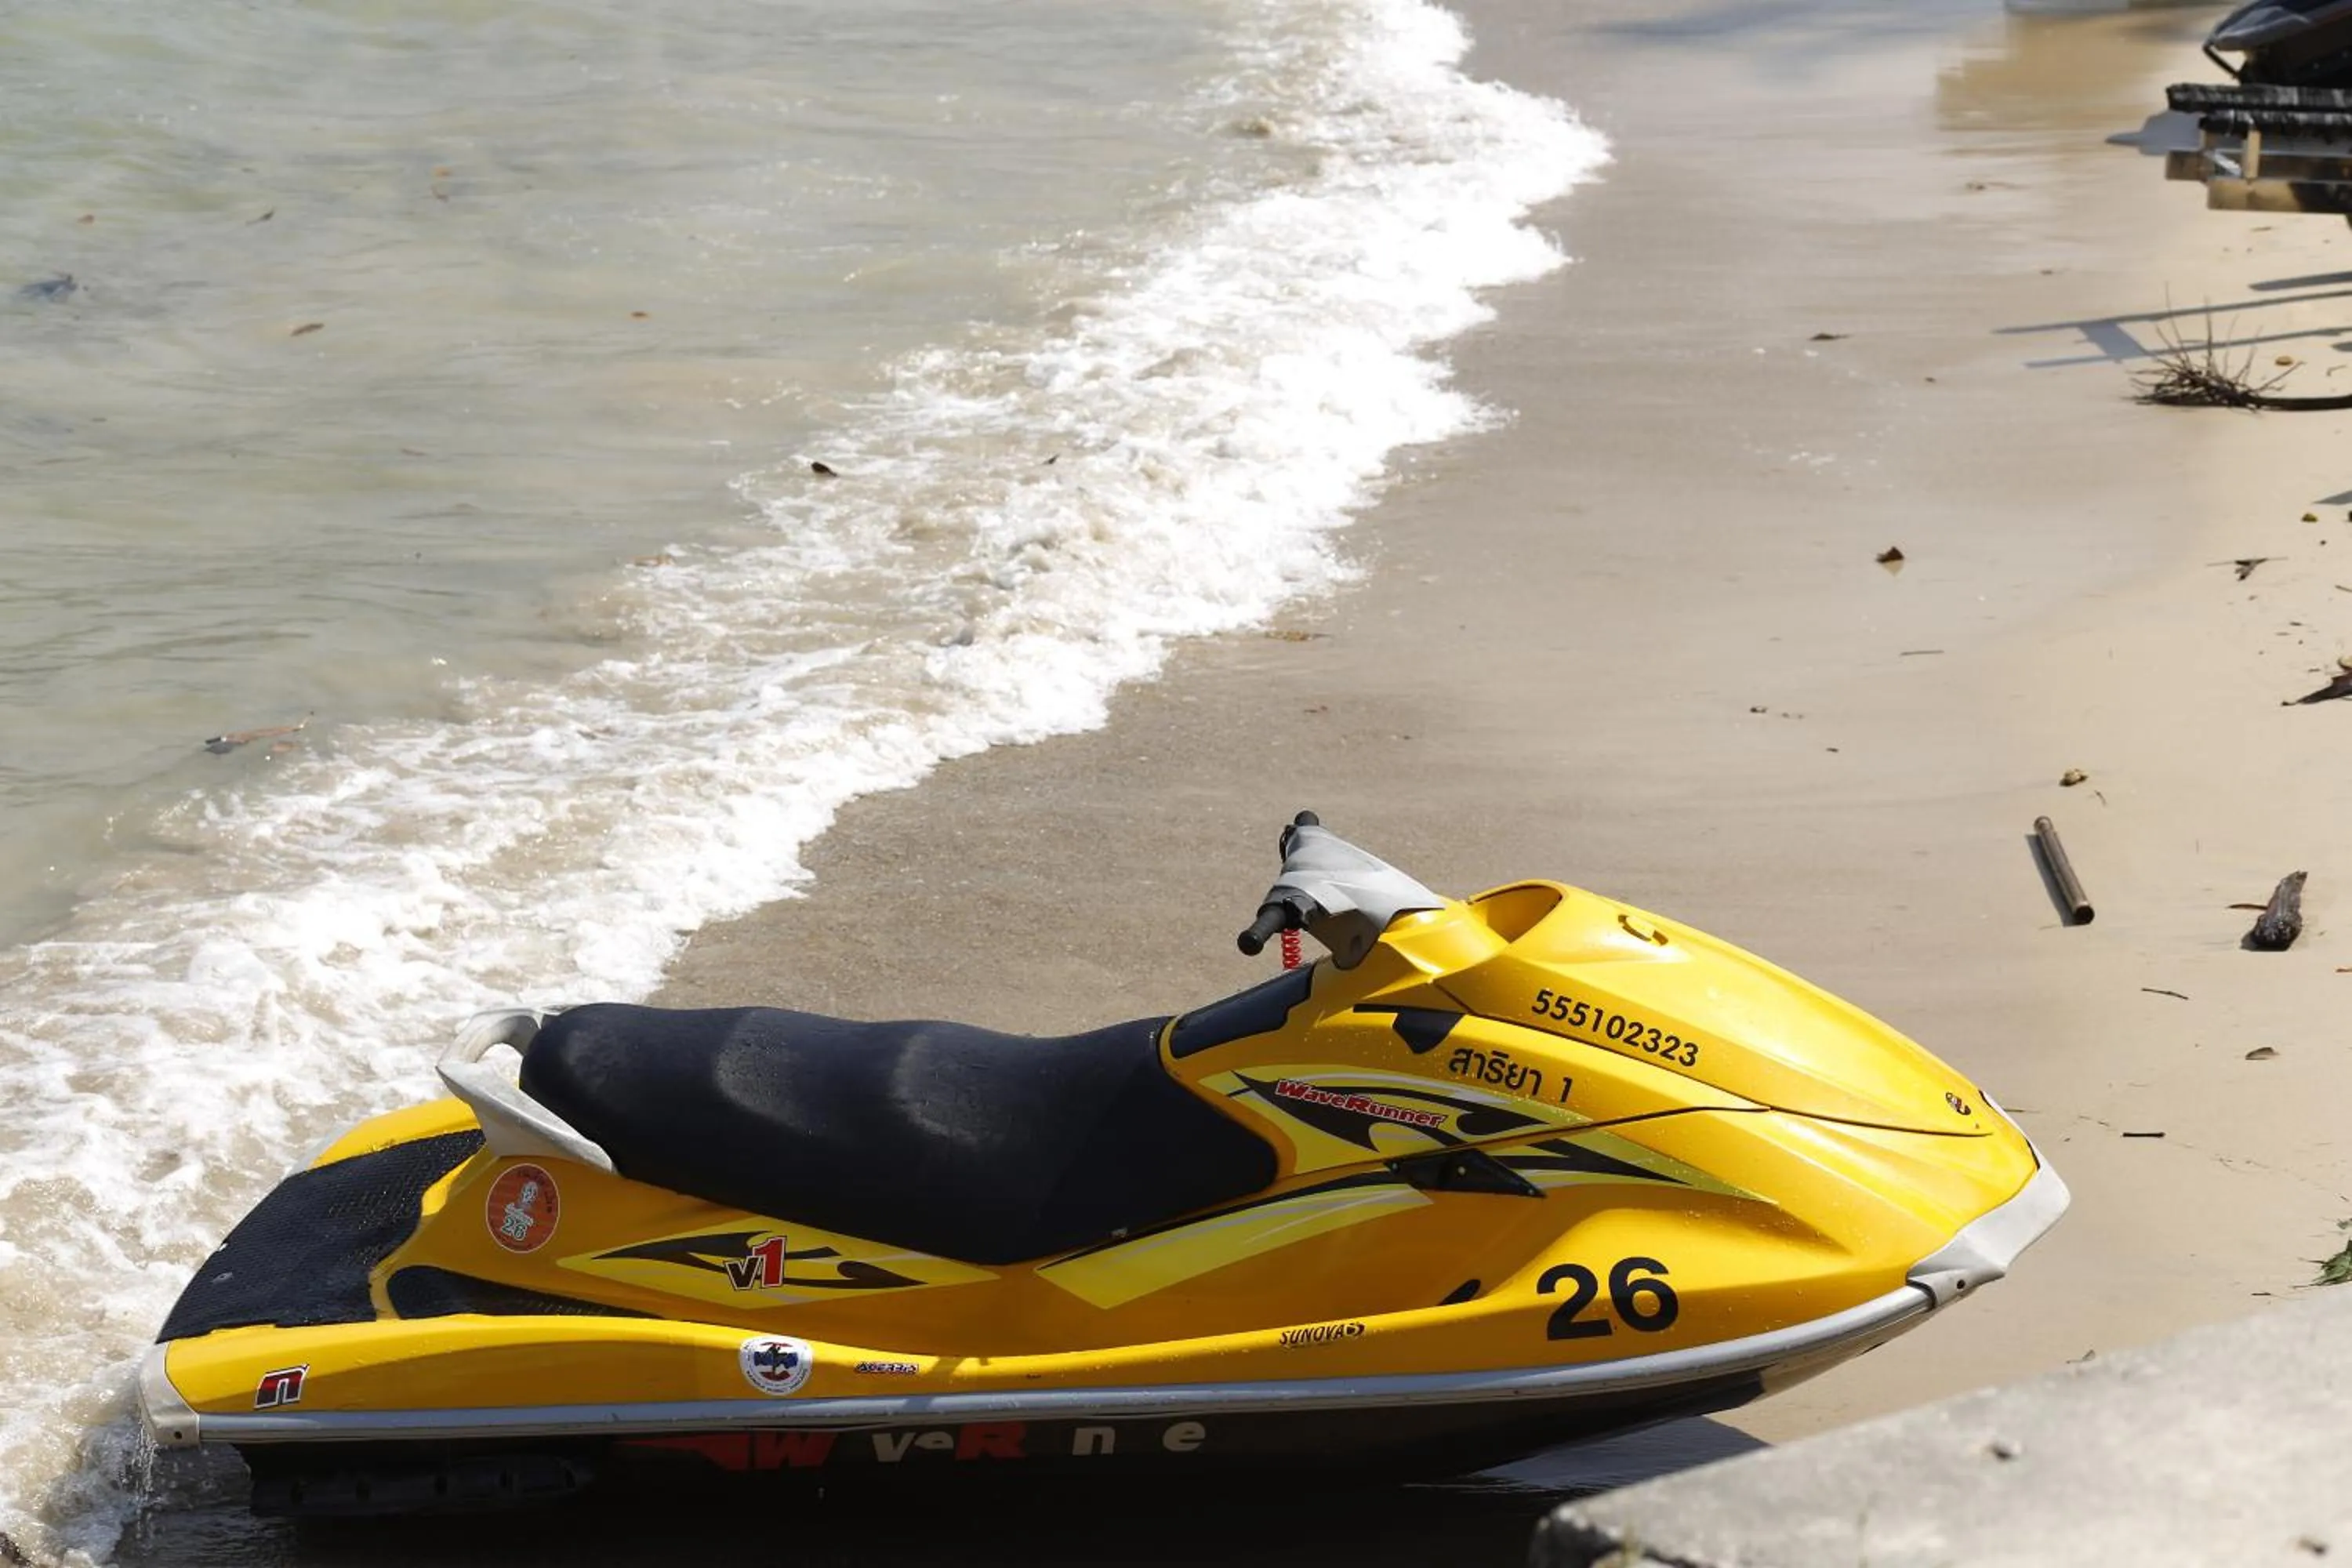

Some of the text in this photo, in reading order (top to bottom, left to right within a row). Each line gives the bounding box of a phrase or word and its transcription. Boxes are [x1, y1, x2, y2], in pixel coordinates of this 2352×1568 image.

[1531, 989, 1700, 1067] 555102323
[1275, 1079, 1447, 1128] WaveRunner
[1559, 1076, 1573, 1103] 1
[501, 1215, 528, 1241] 26
[1537, 1257, 1679, 1341] 26
[1279, 1324, 1345, 1345] SUNOVA
